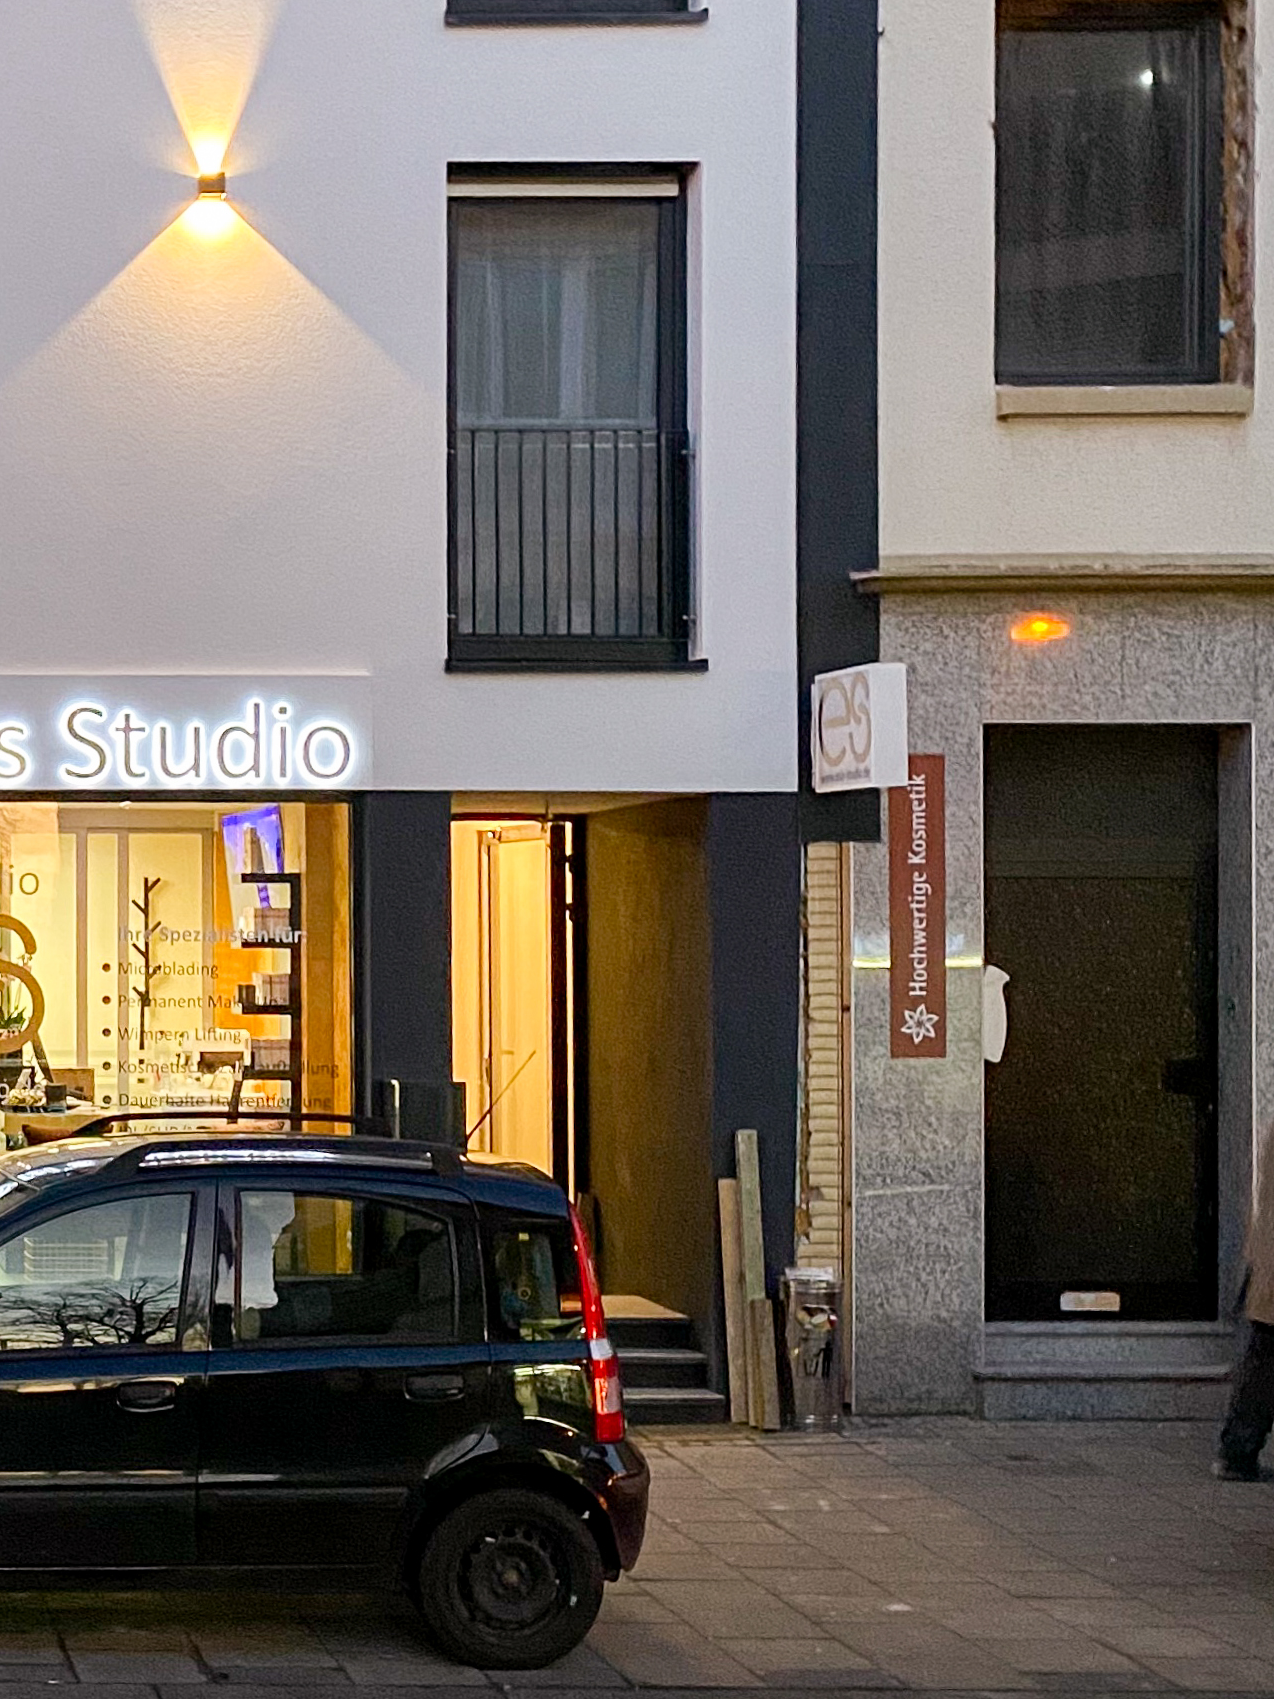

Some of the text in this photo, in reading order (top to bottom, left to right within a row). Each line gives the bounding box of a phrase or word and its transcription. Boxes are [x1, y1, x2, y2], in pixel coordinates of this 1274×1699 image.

[65, 701, 351, 780] Studio
[906, 773, 932, 996] Hochwertige Kosmetik
[117, 961, 220, 978] Micoblading
[117, 1026, 242, 1045] Wimpern Lifting
